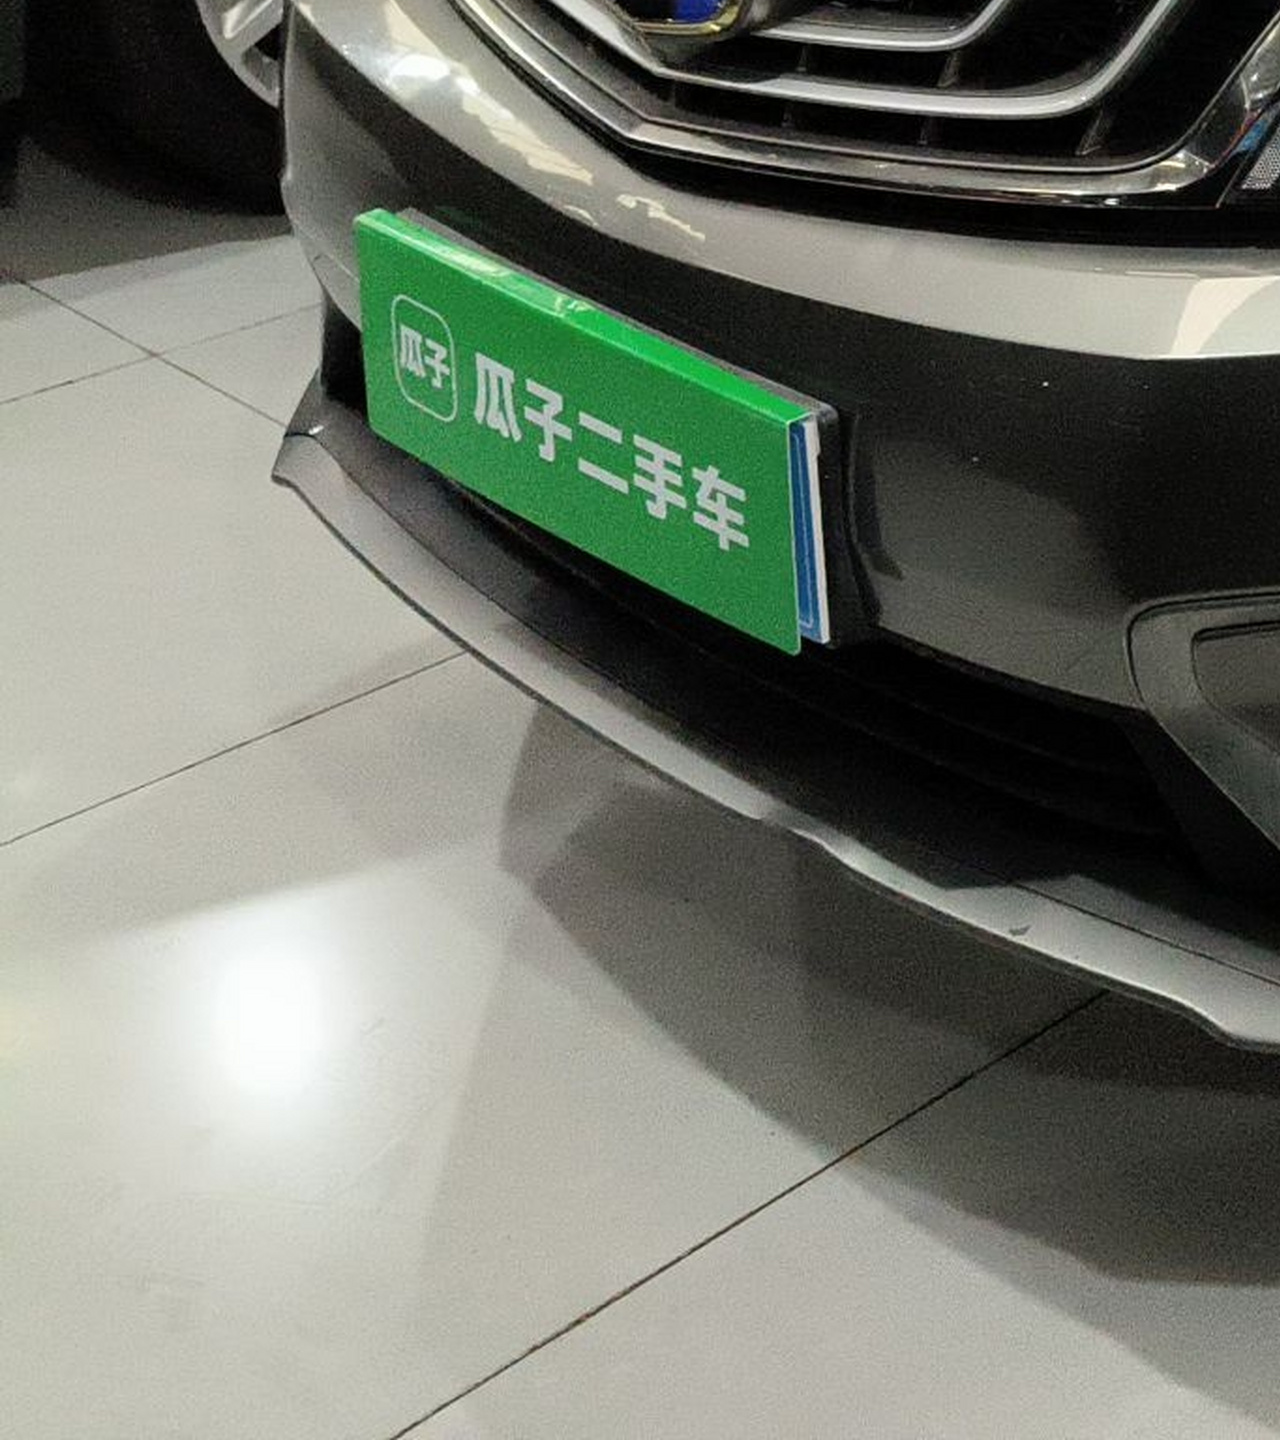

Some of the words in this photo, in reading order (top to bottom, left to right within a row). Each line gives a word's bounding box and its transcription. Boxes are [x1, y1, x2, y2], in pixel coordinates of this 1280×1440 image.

[398, 324, 452, 390] 瓜子
[473, 351, 750, 550] 瓜子二手车
